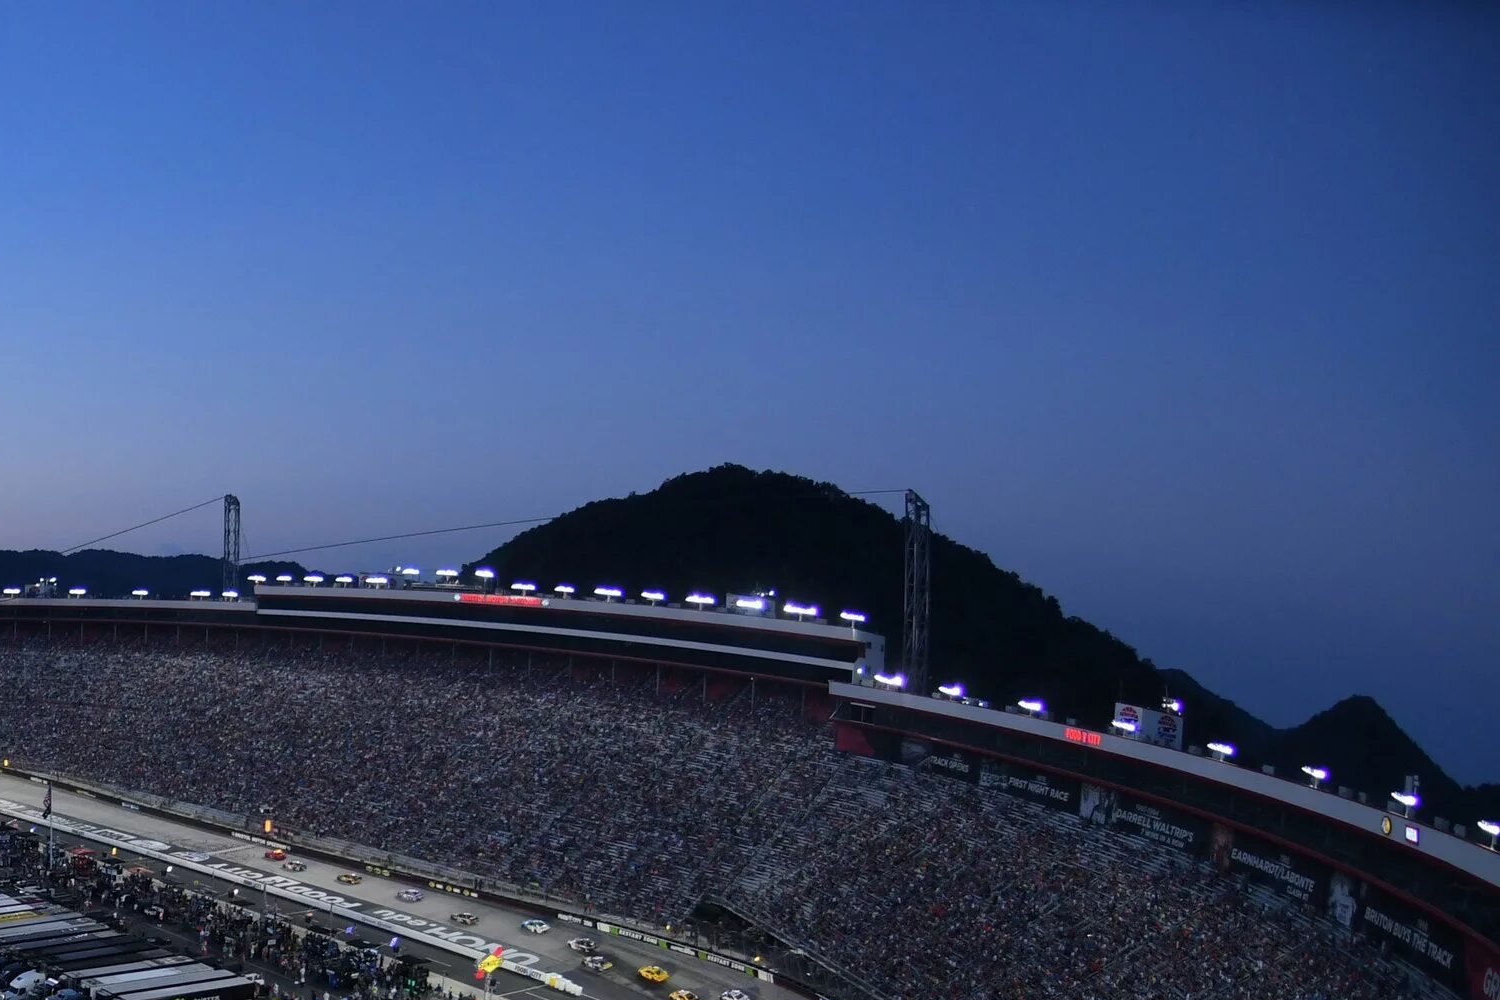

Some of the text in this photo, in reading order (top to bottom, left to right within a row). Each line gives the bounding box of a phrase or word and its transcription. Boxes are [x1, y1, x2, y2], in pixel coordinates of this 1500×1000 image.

[1009, 775, 1027, 791] FIRST
[1027, 781, 1050, 797] NIGHT
[1050, 788, 1070, 802] RACE
[1116, 808, 1151, 829] DARRELL
[1153, 820, 1194, 843] WALTRIP'S
[207, 863, 362, 908] FOOD CITY
[1231, 848, 1316, 893] EARNHARDT/LABONTE
[1365, 905, 1392, 932] BRUTON
[1392, 922, 1411, 944] BUYS
[1412, 932, 1428, 953] THE
[1428, 941, 1454, 968] TRACK
